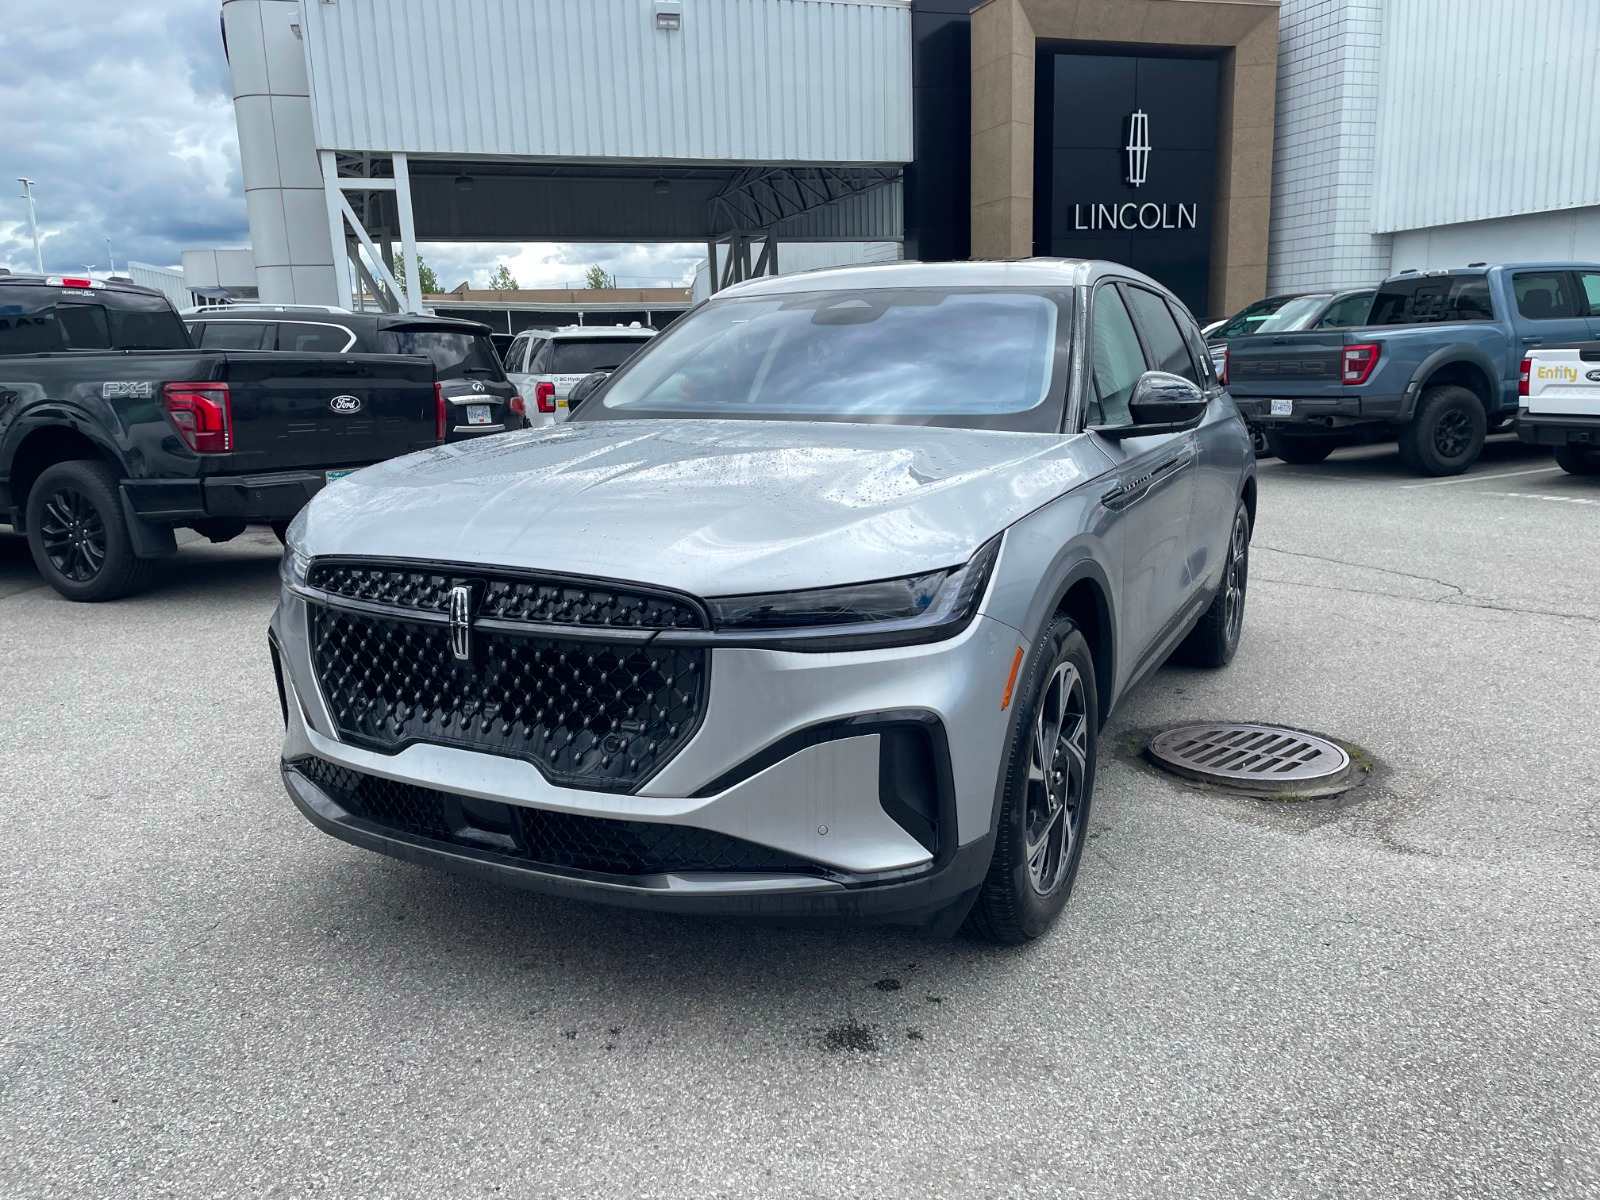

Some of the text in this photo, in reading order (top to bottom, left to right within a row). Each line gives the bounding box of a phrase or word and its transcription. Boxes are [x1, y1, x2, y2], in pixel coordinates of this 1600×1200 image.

[1075, 203, 1197, 229] LINCOLN
[1537, 366, 1577, 382] Entity
[103, 381, 152, 398] FX4
[336, 397, 356, 409] Ford
